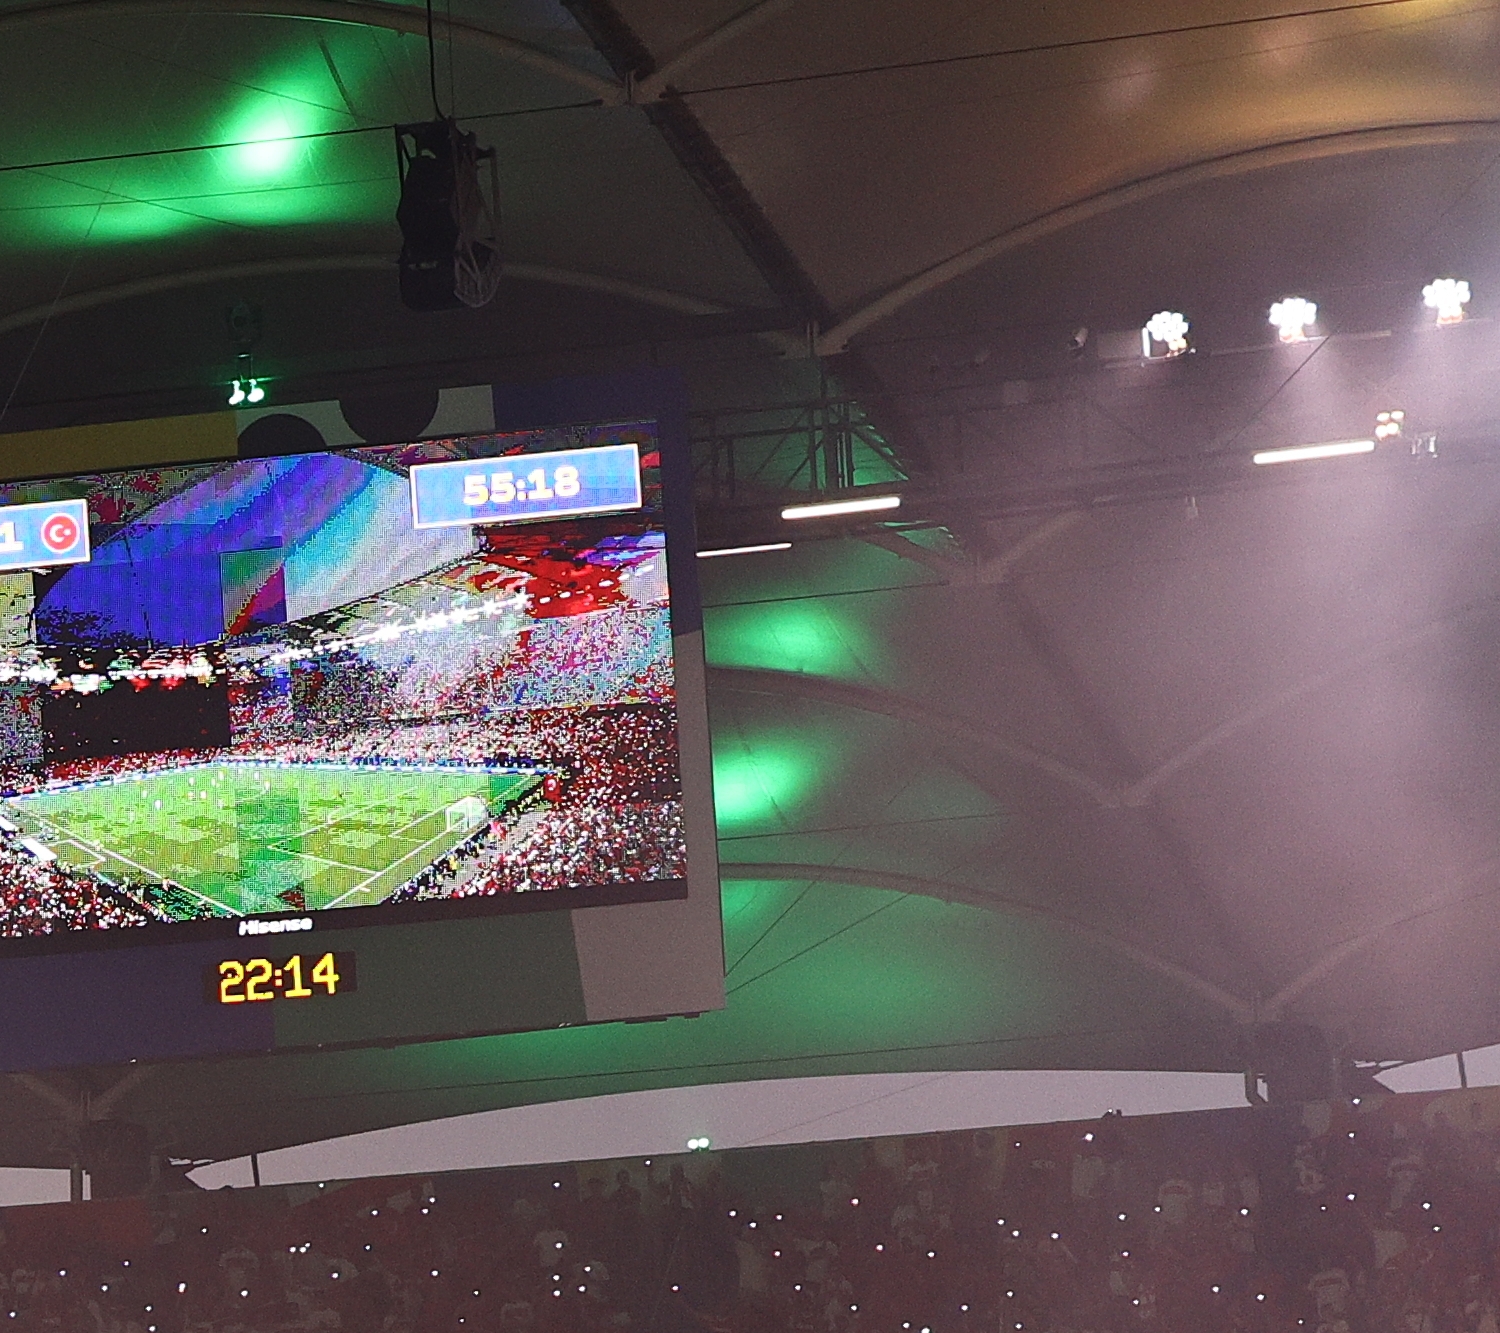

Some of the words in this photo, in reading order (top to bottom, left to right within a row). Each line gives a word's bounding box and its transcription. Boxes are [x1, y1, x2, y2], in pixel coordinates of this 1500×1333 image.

[462, 466, 581, 506] 55:18
[238, 917, 313, 936] Hisense
[218, 952, 340, 1003] 22:14
